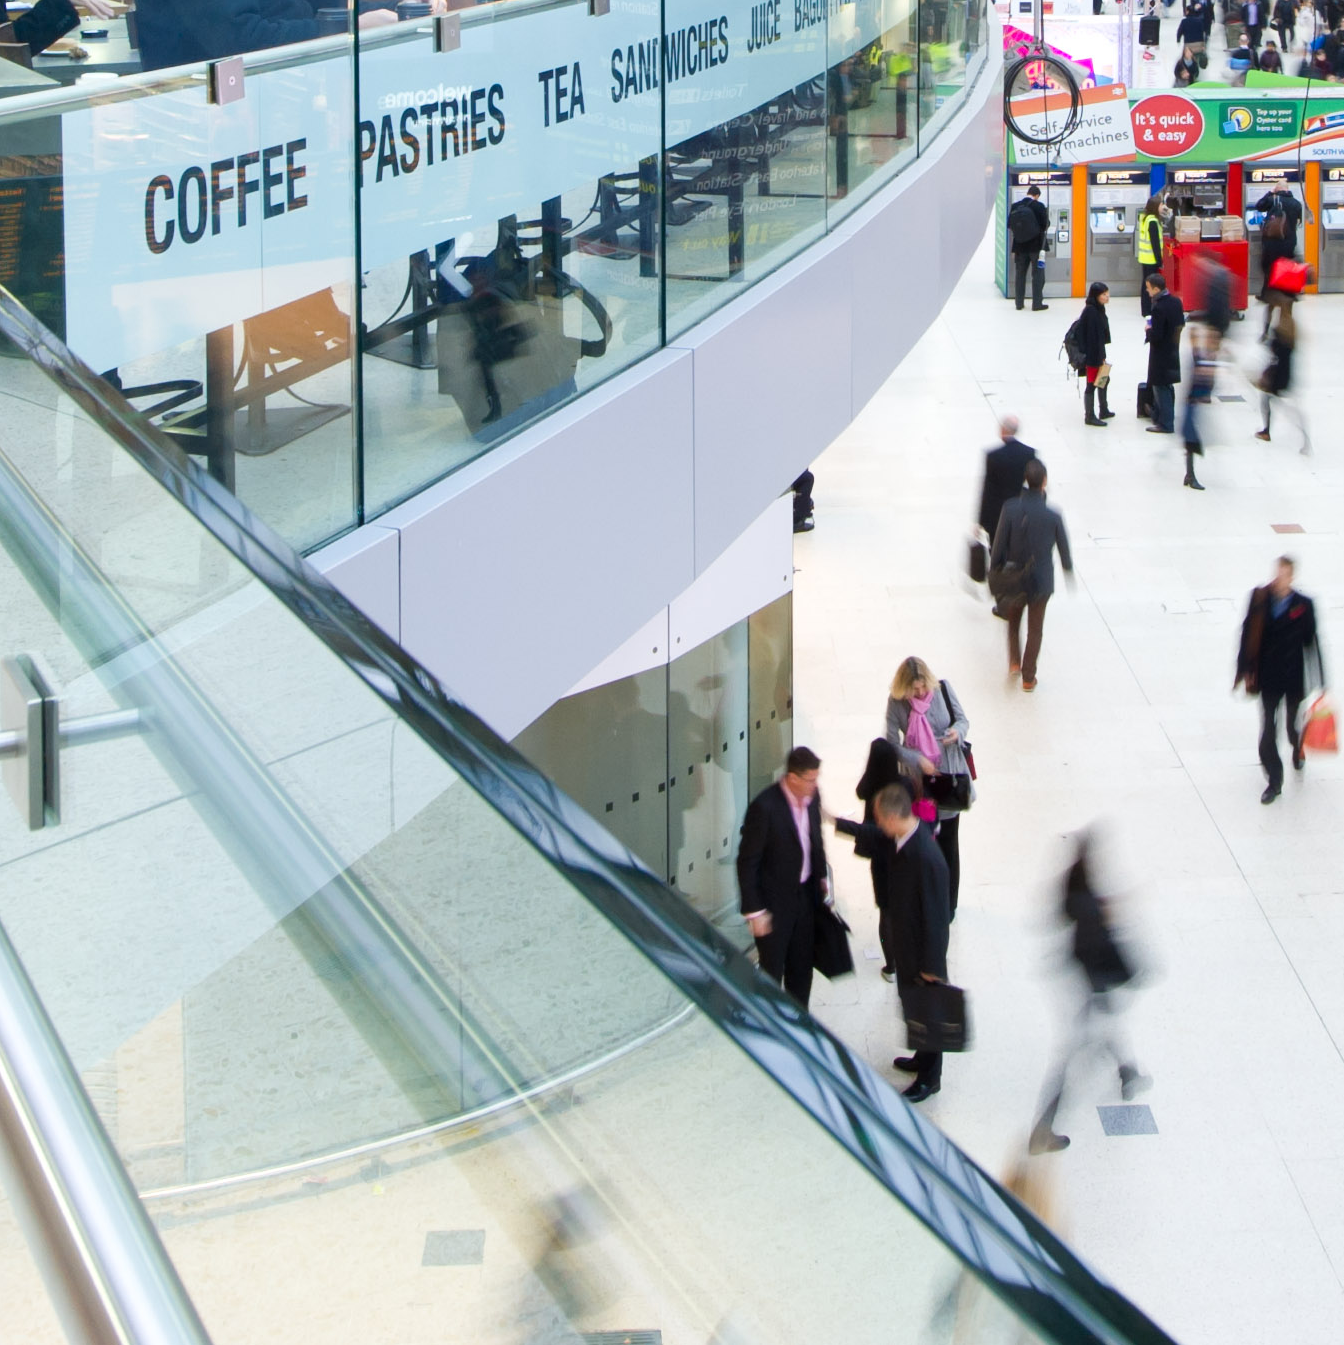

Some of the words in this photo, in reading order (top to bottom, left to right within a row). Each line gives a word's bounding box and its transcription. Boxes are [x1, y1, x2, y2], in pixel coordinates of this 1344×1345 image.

[1268, 109, 1277, 117] up
[1277, 109, 1292, 117] your
[1135, 112, 1156, 125] It's
[1159, 111, 1195, 128] quick
[1256, 116, 1277, 125] Oyster
[1278, 116, 1292, 124] card
[1256, 124, 1270, 132] here
[144, 137, 309, 255] COFFEE
[360, 83, 505, 188] PASTRIES
[538, 61, 585, 128] TEA
[610, 15, 729, 103] SANDWICHES
[1064, 131, 1129, 150] machines
[1143, 129, 1154, 141] &
[1157, 130, 1187, 144] easy
[1312, 148, 1336, 156] SOUTH
